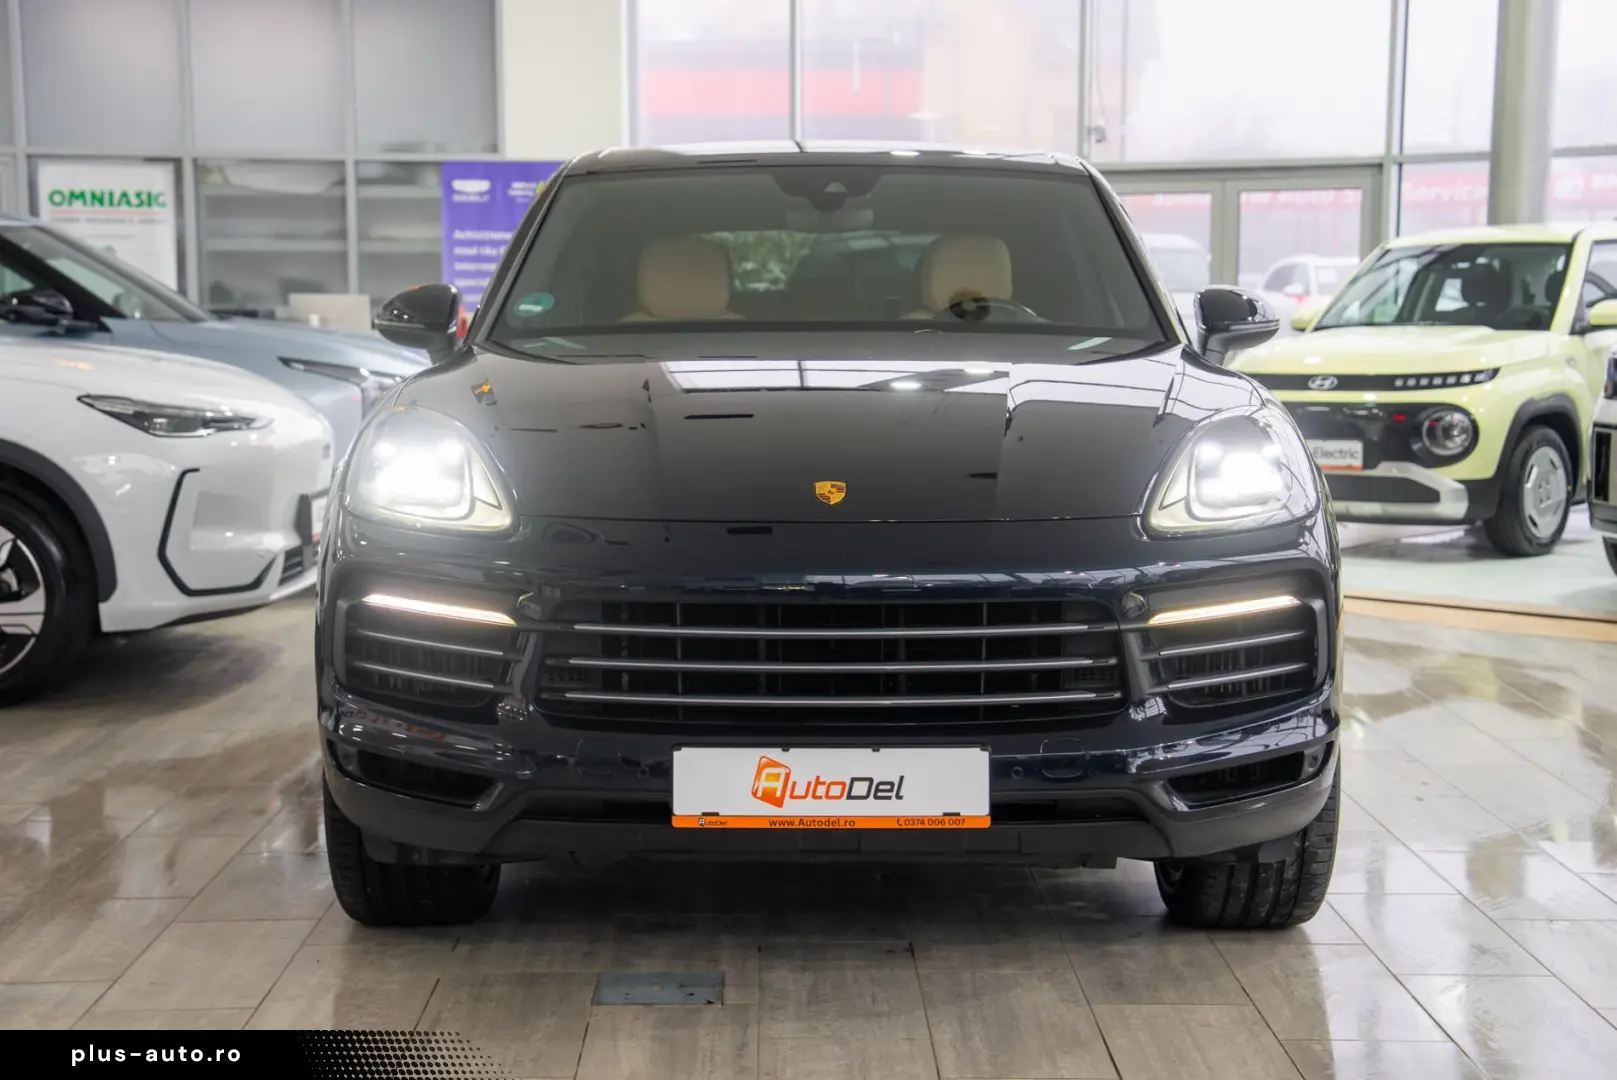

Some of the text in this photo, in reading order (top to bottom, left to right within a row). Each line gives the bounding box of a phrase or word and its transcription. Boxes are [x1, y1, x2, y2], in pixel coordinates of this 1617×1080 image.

[1313, 446, 1360, 460] Electric
[754, 764, 905, 803] AutoDel
[768, 817, 856, 828] www.Autodel.ro
[903, 818, 966, 827] 0374 006 007
